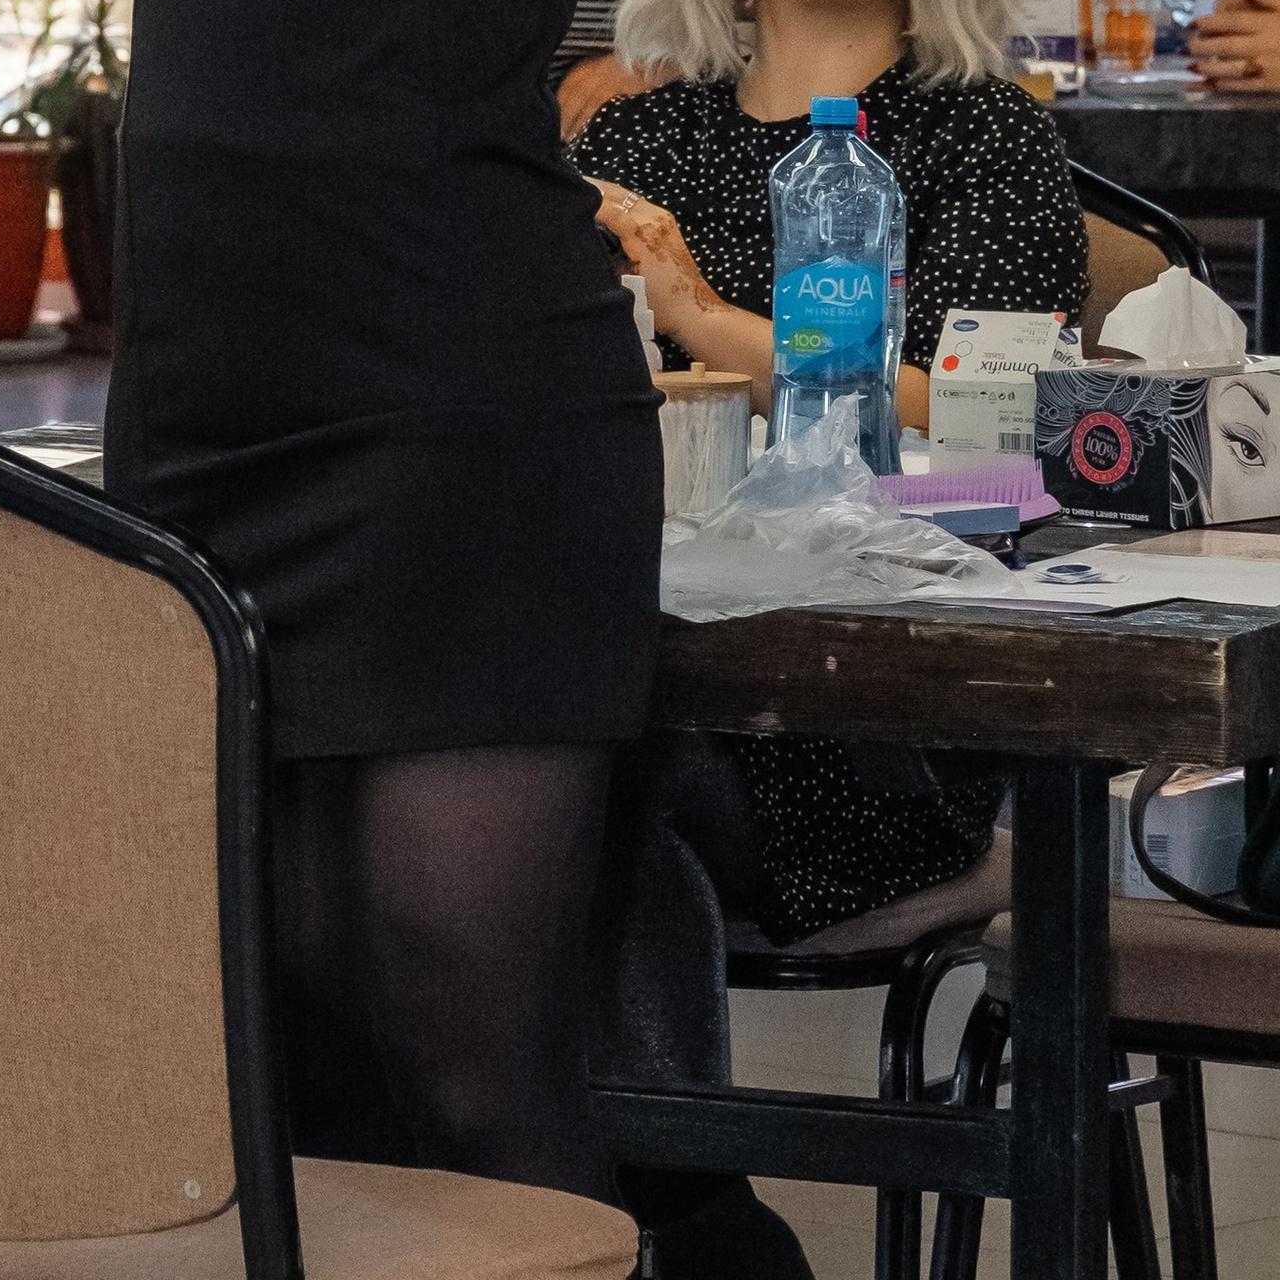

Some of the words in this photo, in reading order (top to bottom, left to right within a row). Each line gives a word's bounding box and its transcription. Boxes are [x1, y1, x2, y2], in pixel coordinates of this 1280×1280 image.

[798, 273, 874, 308] AQUA
[804, 307, 868, 317] MINERALE
[793, 333, 835, 349] 100%
[1085, 436, 1119, 461] 100%
